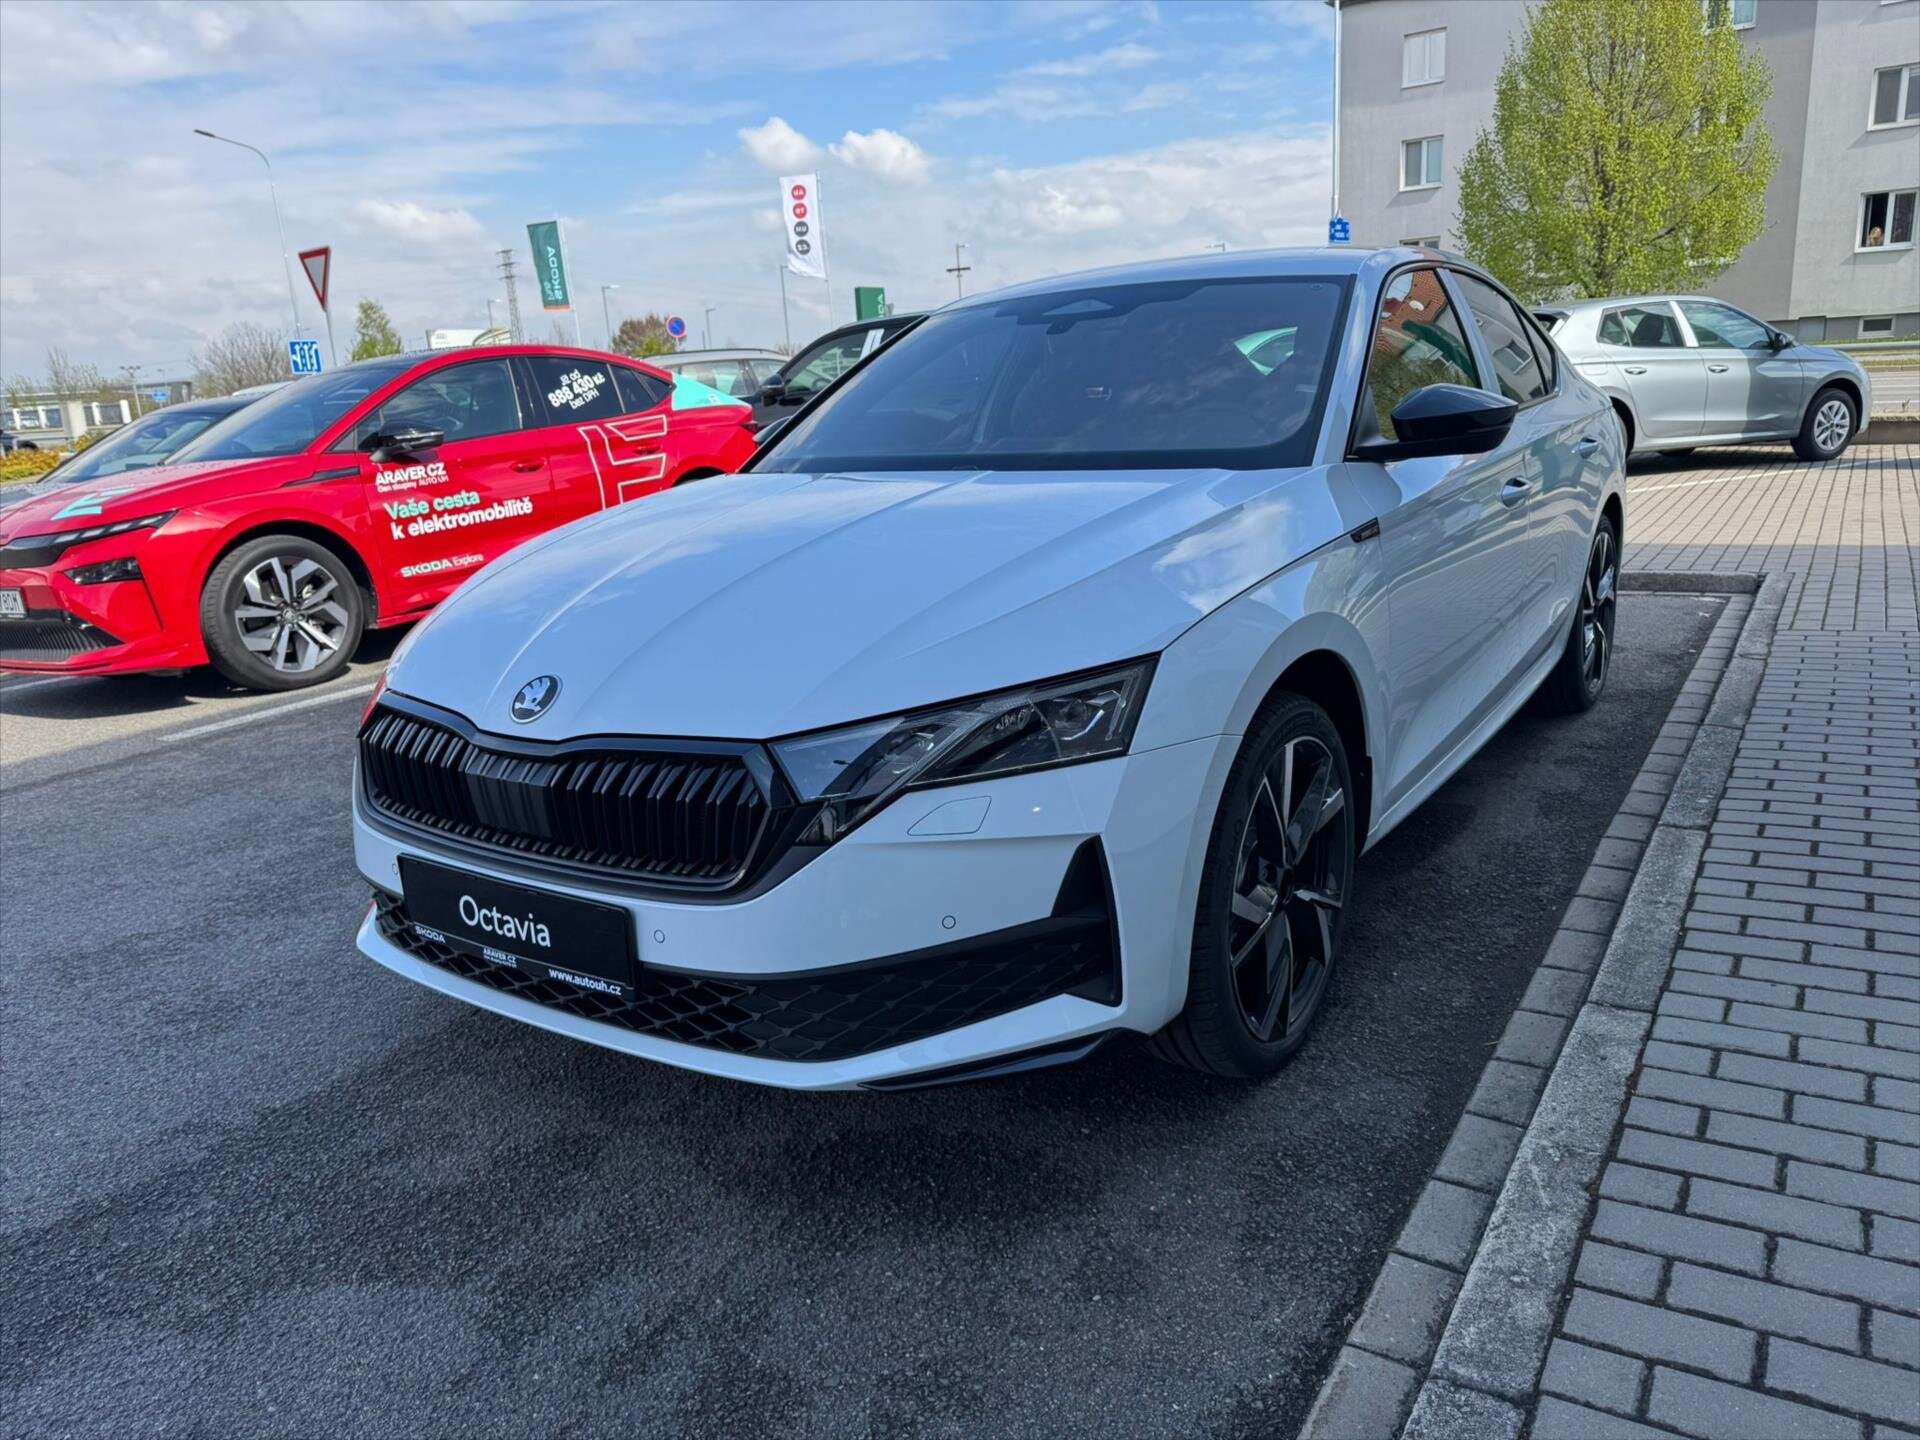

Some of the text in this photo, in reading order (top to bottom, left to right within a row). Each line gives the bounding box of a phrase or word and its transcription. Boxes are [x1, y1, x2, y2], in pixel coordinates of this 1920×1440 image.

[569, 368, 581, 380] od
[547, 385, 574, 407] 888
[572, 374, 595, 394] 430
[568, 388, 600, 410] bez DPH
[418, 476, 437, 487] AUTO
[383, 489, 481, 520] Vaše cesta
[390, 496, 533, 541] k elektromobilitě
[459, 894, 551, 948] Octavia
[548, 968, 622, 995] www.autouh.cz
